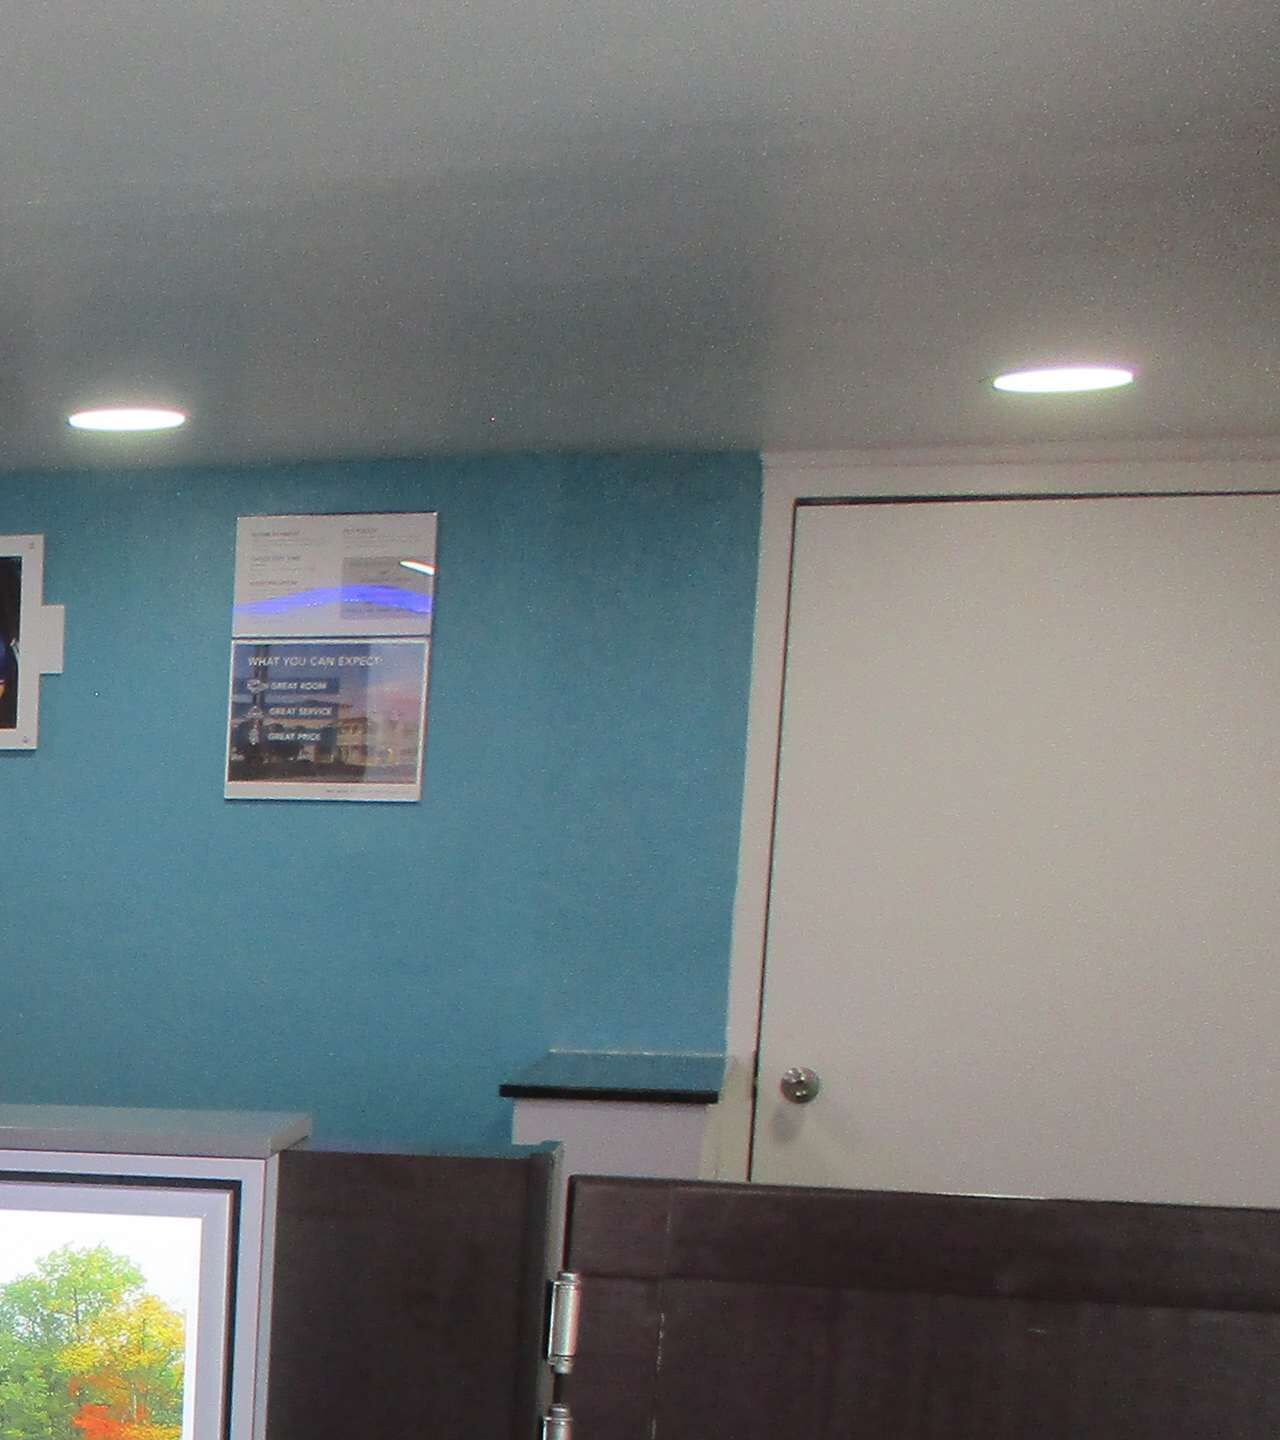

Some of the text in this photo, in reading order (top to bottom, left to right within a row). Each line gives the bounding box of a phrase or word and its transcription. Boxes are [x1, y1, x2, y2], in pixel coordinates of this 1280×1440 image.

[248, 656, 280, 667] WHAT
[283, 656, 307, 667] YOU
[311, 656, 335, 667] CAN
